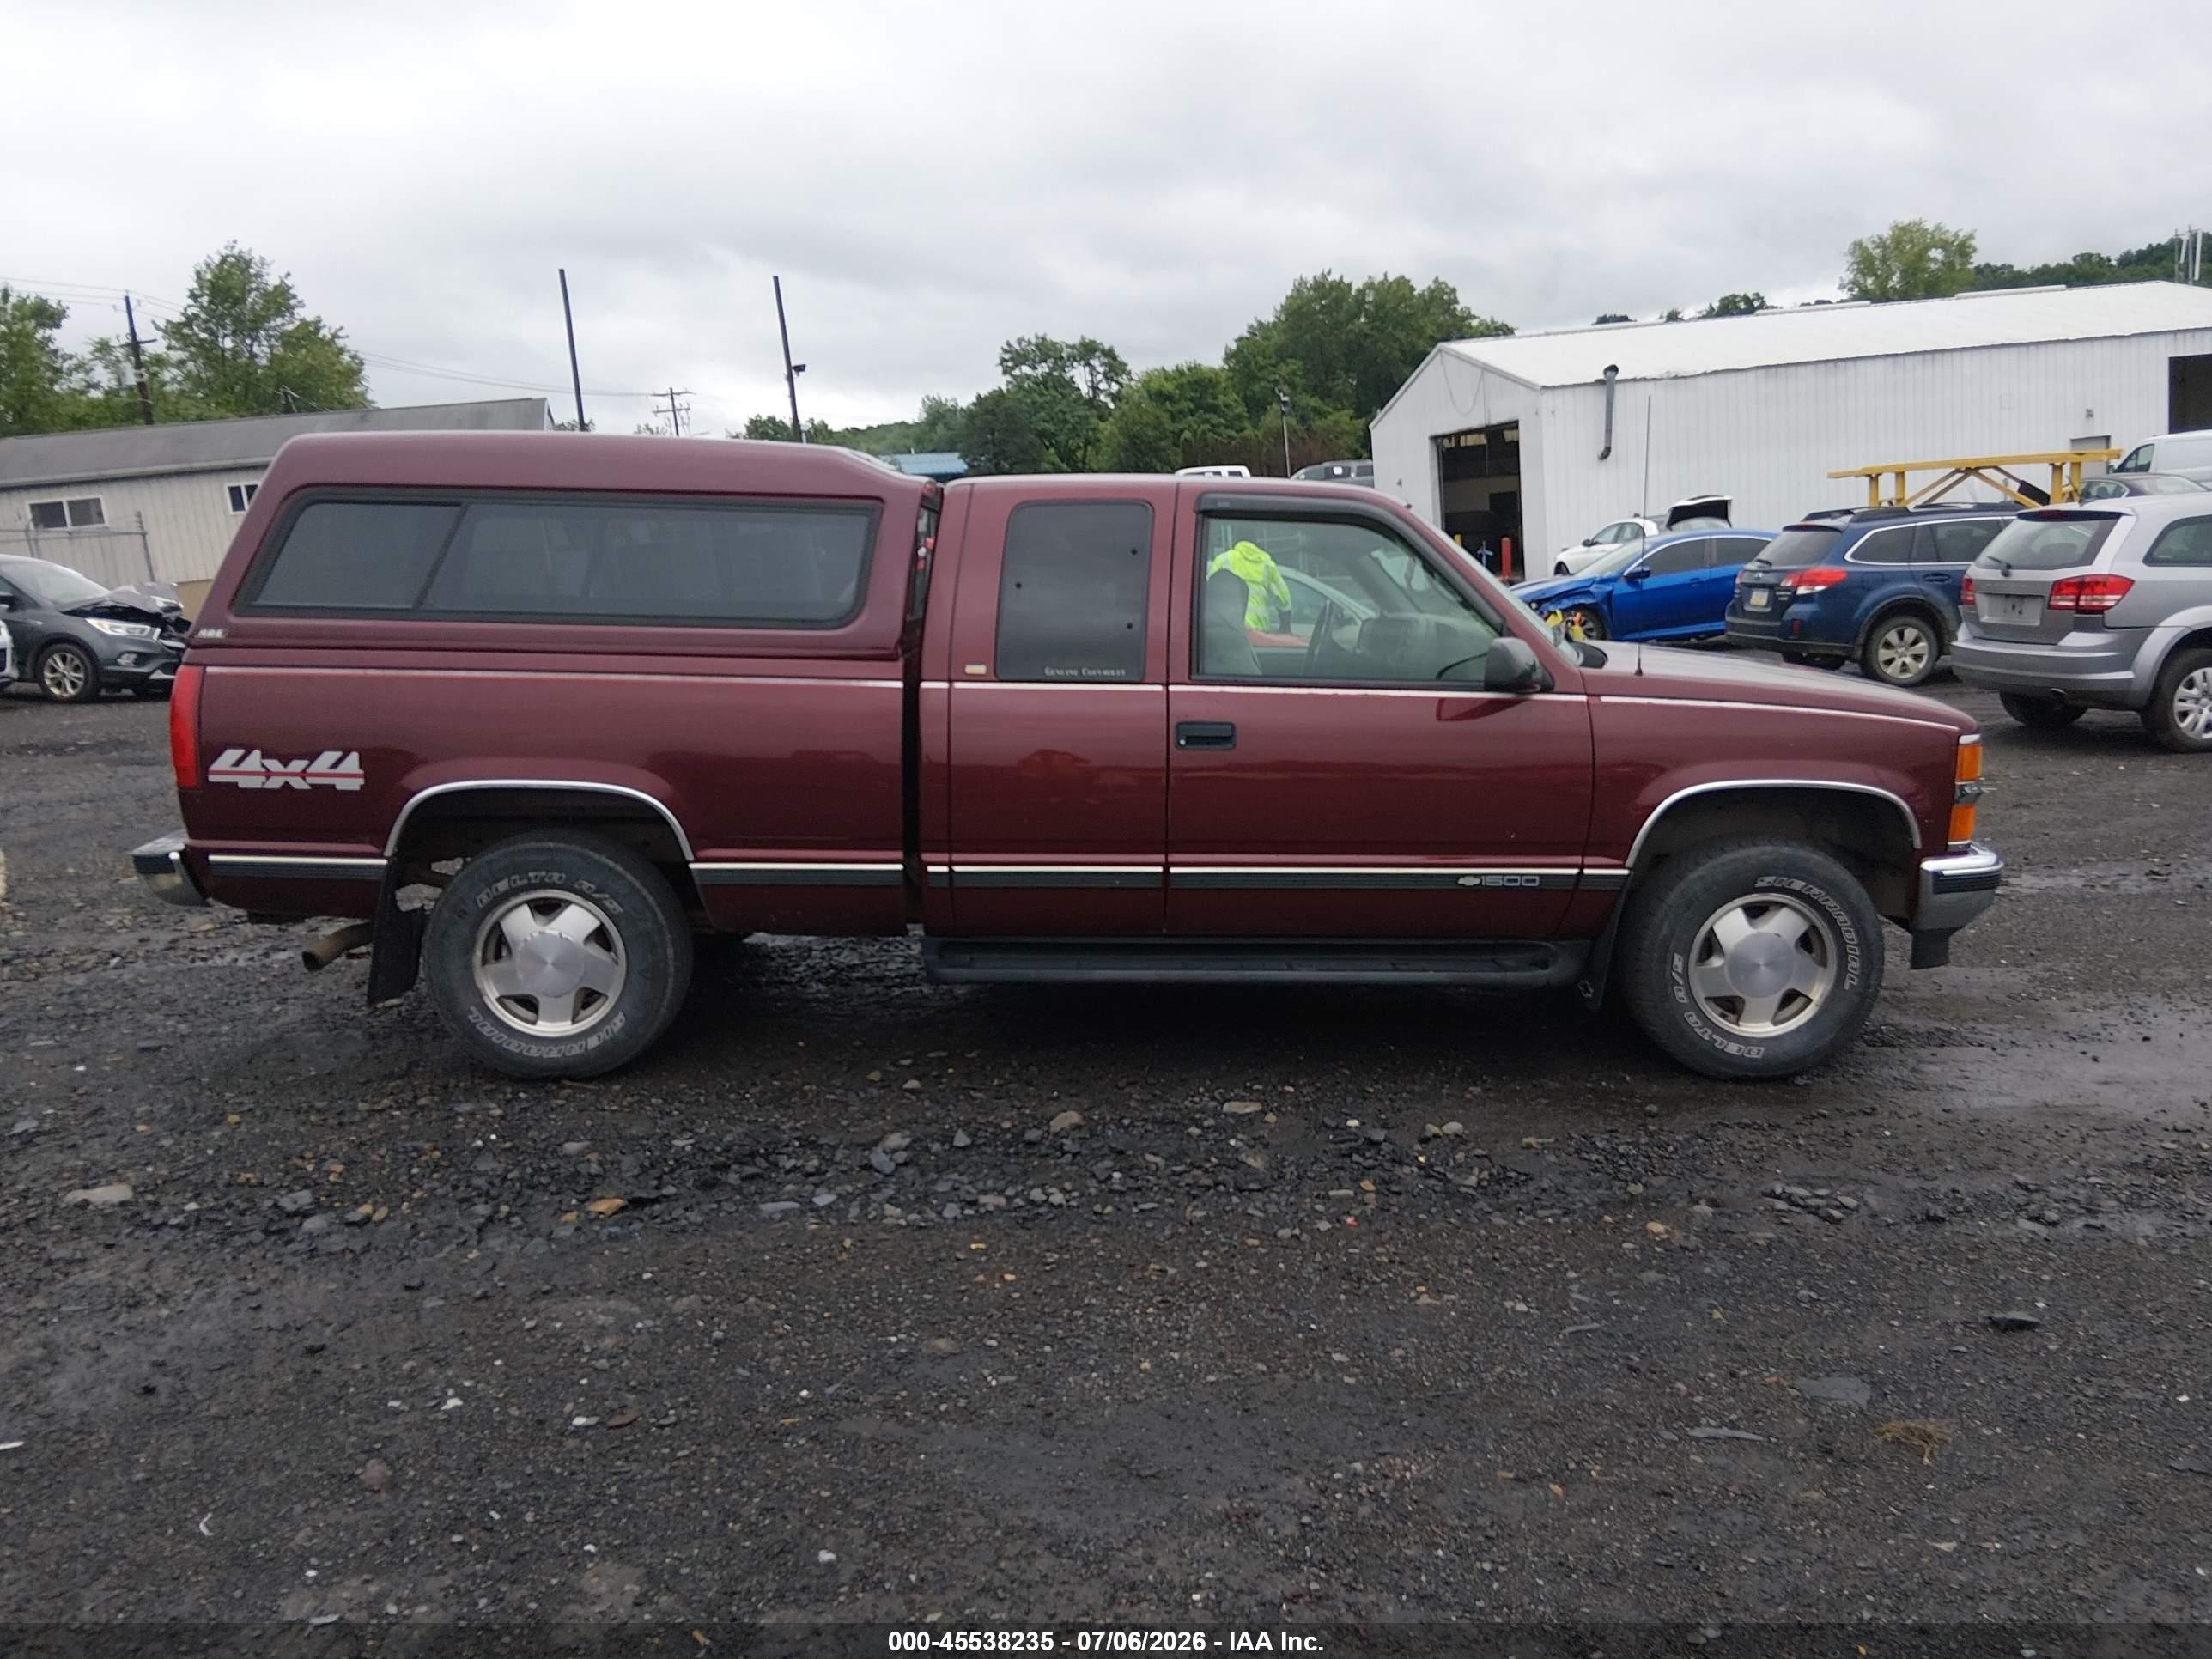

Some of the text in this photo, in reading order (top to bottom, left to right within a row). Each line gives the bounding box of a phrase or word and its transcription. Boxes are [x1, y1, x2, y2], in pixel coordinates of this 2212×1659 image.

[208, 748, 366, 791] 4x4
[1481, 875, 1540, 887] 1500
[1683, 1011, 1766, 1060] DELTA
